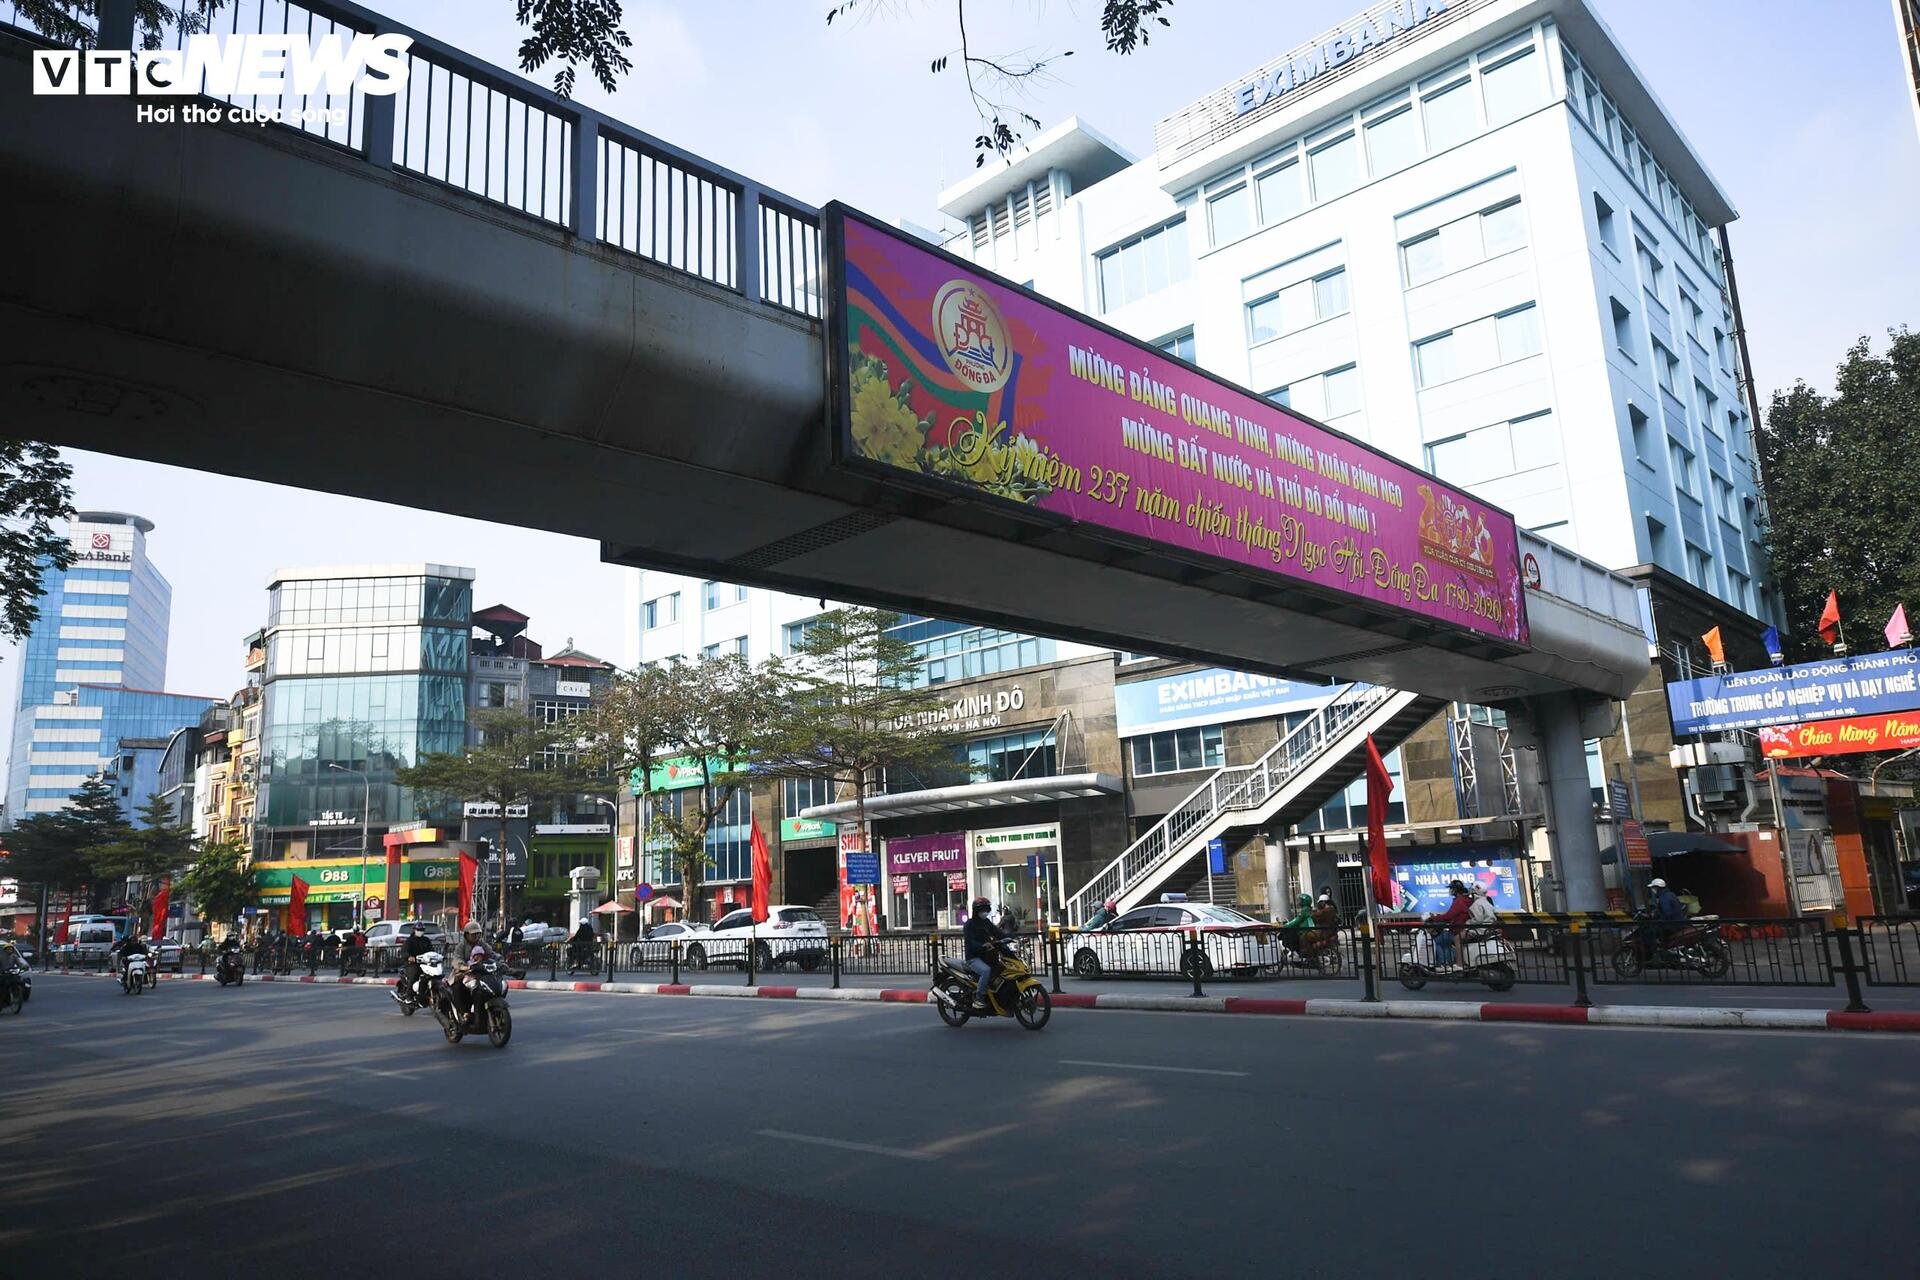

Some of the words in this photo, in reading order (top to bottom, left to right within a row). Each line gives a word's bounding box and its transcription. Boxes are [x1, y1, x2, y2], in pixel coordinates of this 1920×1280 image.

[1068, 344, 1126, 397] MỪNG
[1129, 367, 1177, 417] ĐẢNG
[1181, 393, 1232, 440] QUANG
[1234, 415, 1273, 459] VINH,
[1275, 433, 1315, 472] MỪNG
[1317, 450, 1350, 486] XUÂN
[1351, 464, 1379, 498] BÍNH
[1380, 477, 1403, 513] NGỌ
[1121, 416, 1175, 464] MỪNG
[1178, 434, 1208, 476] ĐẤT
[1211, 450, 1254, 492] NƯỚC
[1255, 466, 1275, 500] VÀ
[1276, 474, 1303, 509] THỦ
[1304, 485, 1323, 517] ĐÔ
[1324, 489, 1346, 525] ĐỔI
[1347, 502, 1370, 534] MỚI
[1087, 464, 1131, 509] 237
[1135, 486, 1181, 524] năm
[1186, 489, 1232, 540] chiến
[1235, 504, 1283, 563] thắng
[1281, 513, 1327, 573] Ngọc
[76, 551, 131, 563] eABank
[1725, 677, 1748, 689] LIÊN
[1749, 671, 1785, 686] ĐOÀN
[1786, 670, 1809, 680] LAO
[1811, 664, 1849, 678] ĐỘNG
[1850, 657, 1890, 672] THÀNH
[1891, 653, 1918, 665] PHỐ
[953, 693, 993, 720] KINH
[995, 684, 1025, 713] ĐÔ
[1689, 696, 1729, 719] TRƯỜNG
[1728, 693, 1764, 713] TRUNG
[1764, 686, 1786, 709] CẤP
[1787, 683, 1826, 706] NGHIỆP
[1826, 683, 1843, 703] VỤ
[1843, 678, 1861, 699] VÀ
[1860, 677, 1884, 699] DẠY
[1884, 668, 1917, 694] NGHỀ
[965, 718, 980, 730] HÀ
[983, 714, 1001, 727] NỘI
[1799, 725, 1833, 747] Chúc
[1838, 723, 1878, 745] Mừng
[1884, 719, 1920, 738] Năm
[893, 851, 930, 864] KLEVER
[932, 848, 960, 861] FRUIT
[320, 869, 349, 883] F88
[617, 869, 634, 881] KFC
[1415, 871, 1441, 886] NHÀ
